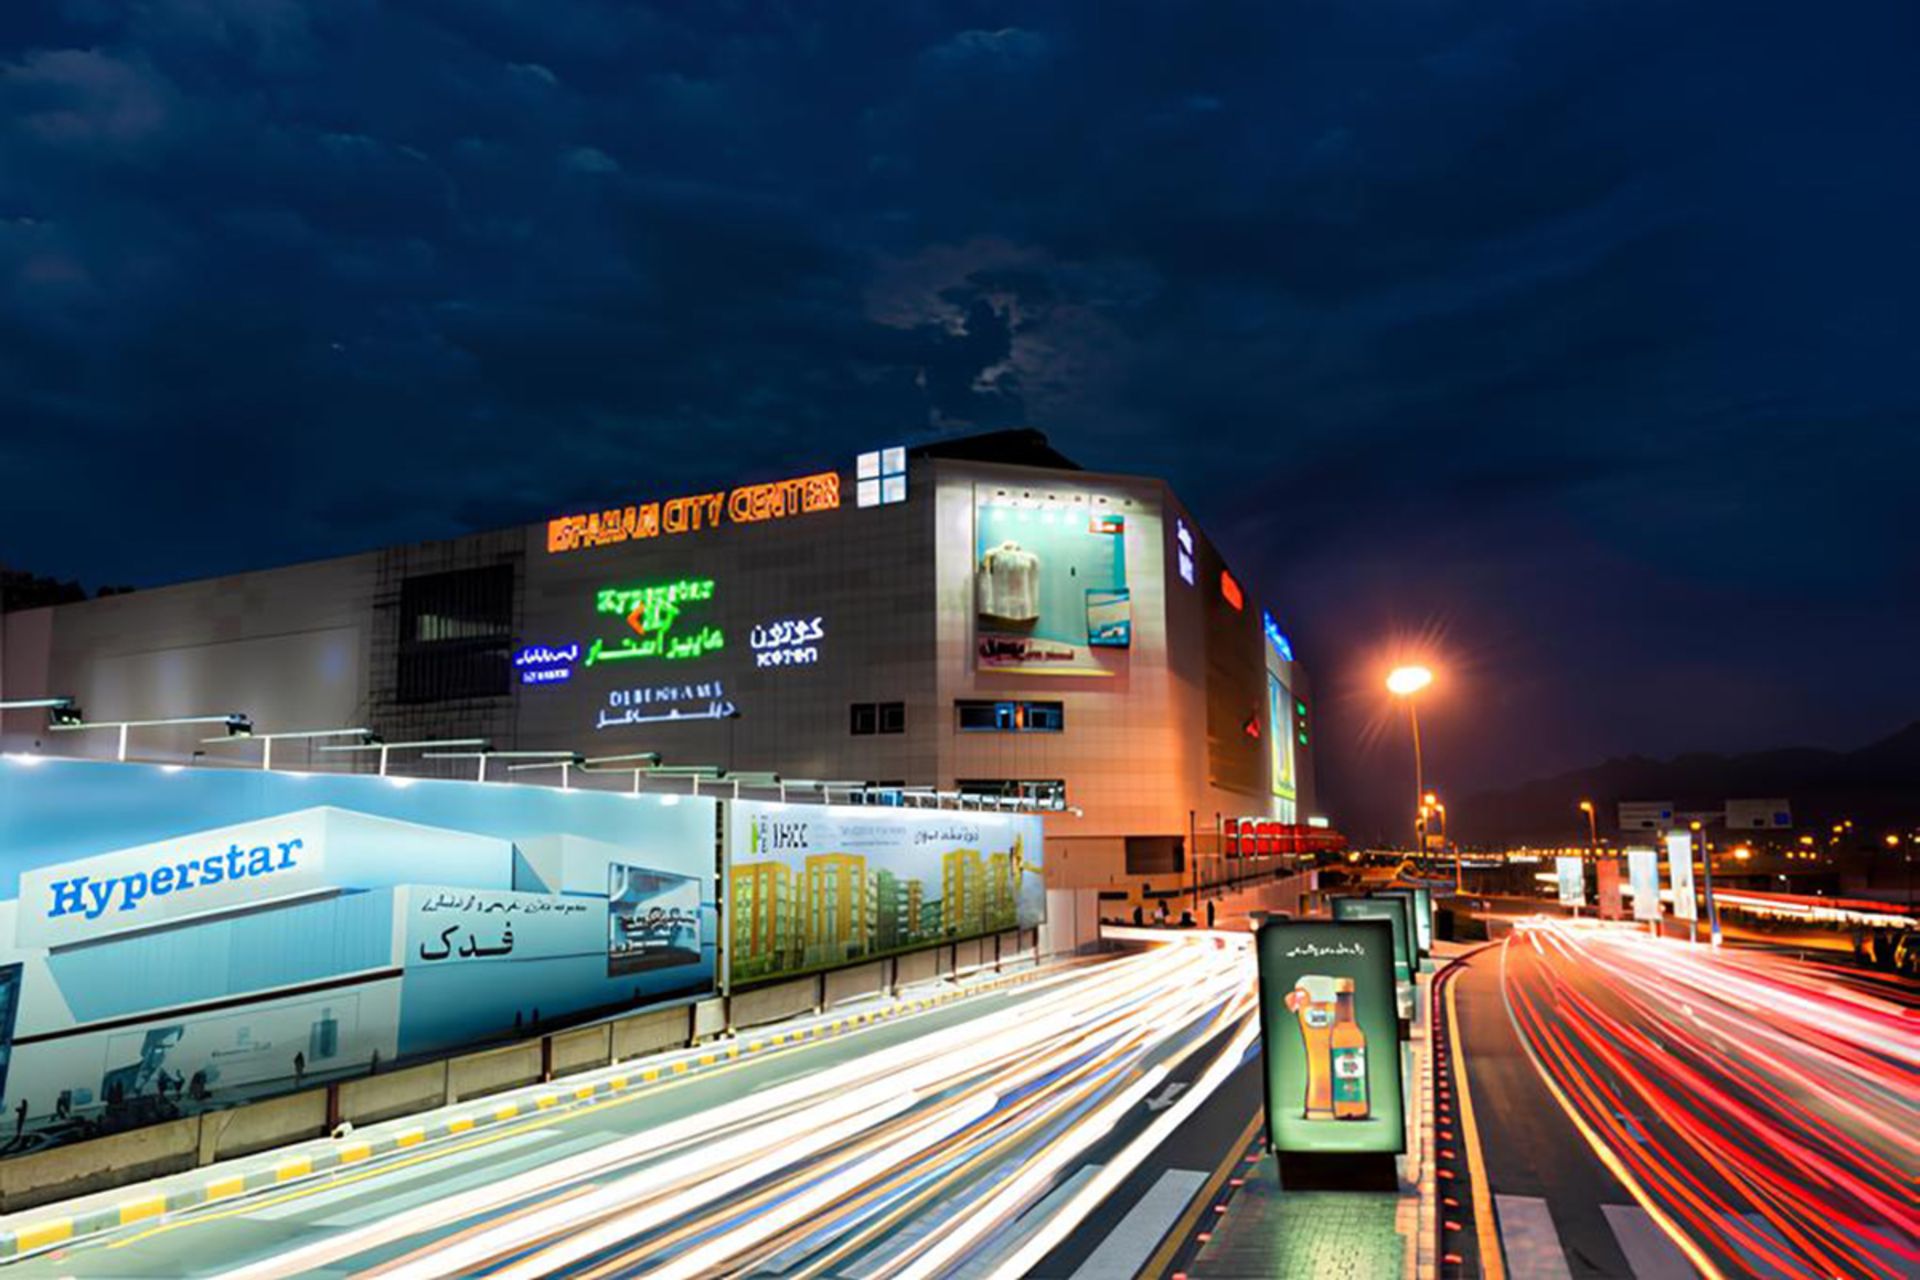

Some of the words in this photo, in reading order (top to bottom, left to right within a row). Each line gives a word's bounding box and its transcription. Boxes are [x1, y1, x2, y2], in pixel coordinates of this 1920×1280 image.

[662, 492, 725, 534] CITY
[48, 838, 304, 920] Hyperstar
[420, 921, 513, 960] فدک
